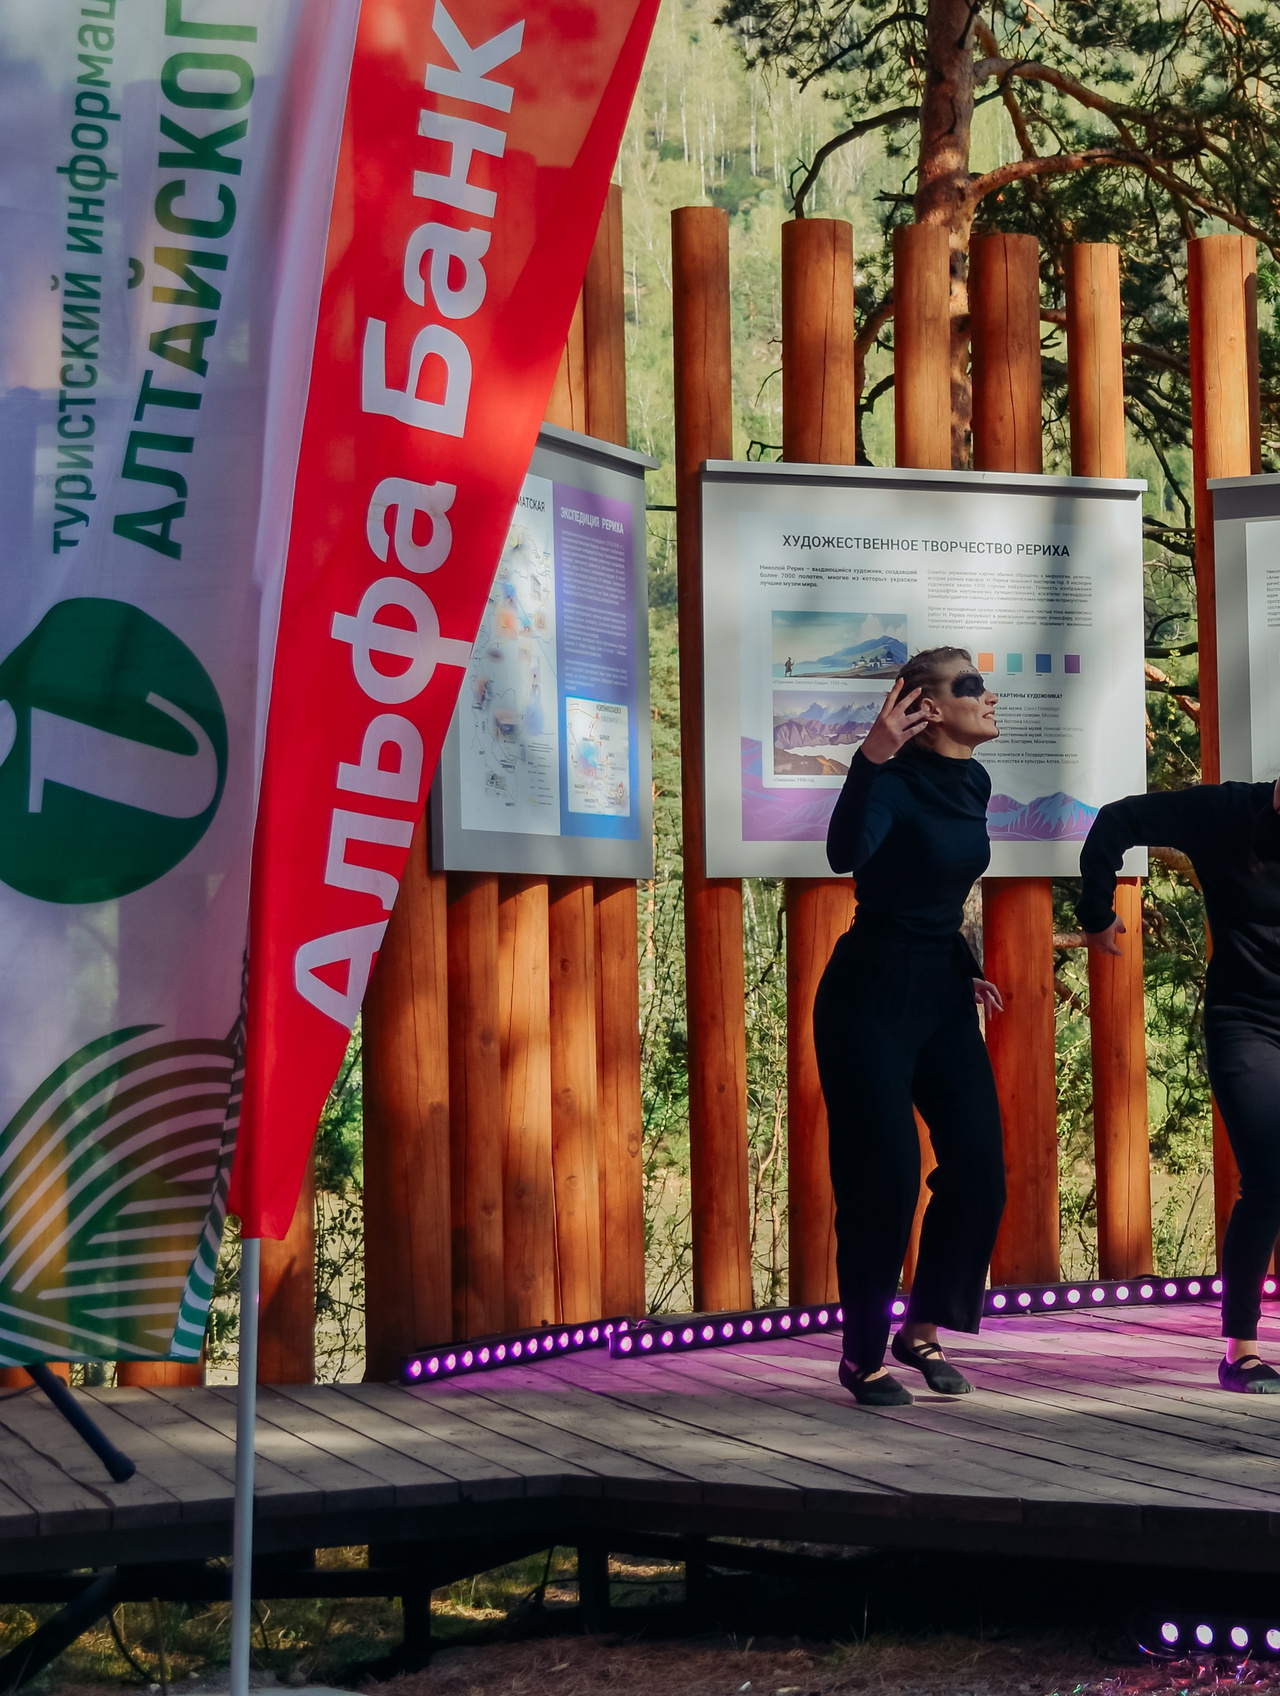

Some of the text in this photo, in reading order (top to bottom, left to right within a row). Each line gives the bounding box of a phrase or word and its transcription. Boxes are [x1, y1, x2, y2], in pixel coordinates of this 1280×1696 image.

[50, 273, 102, 554] туристский
[112, 0, 258, 561] АЛТАЙСКОГ
[292, 0, 529, 1035] Альфа Банк
[560, 506, 625, 534] ЭКСПЕДИЦИЯ РЕРИХА
[782, 534, 1071, 557] ХУДОЖЕСТВЕННОЕ ТВОРЧЕСТВО РЕРИХА
